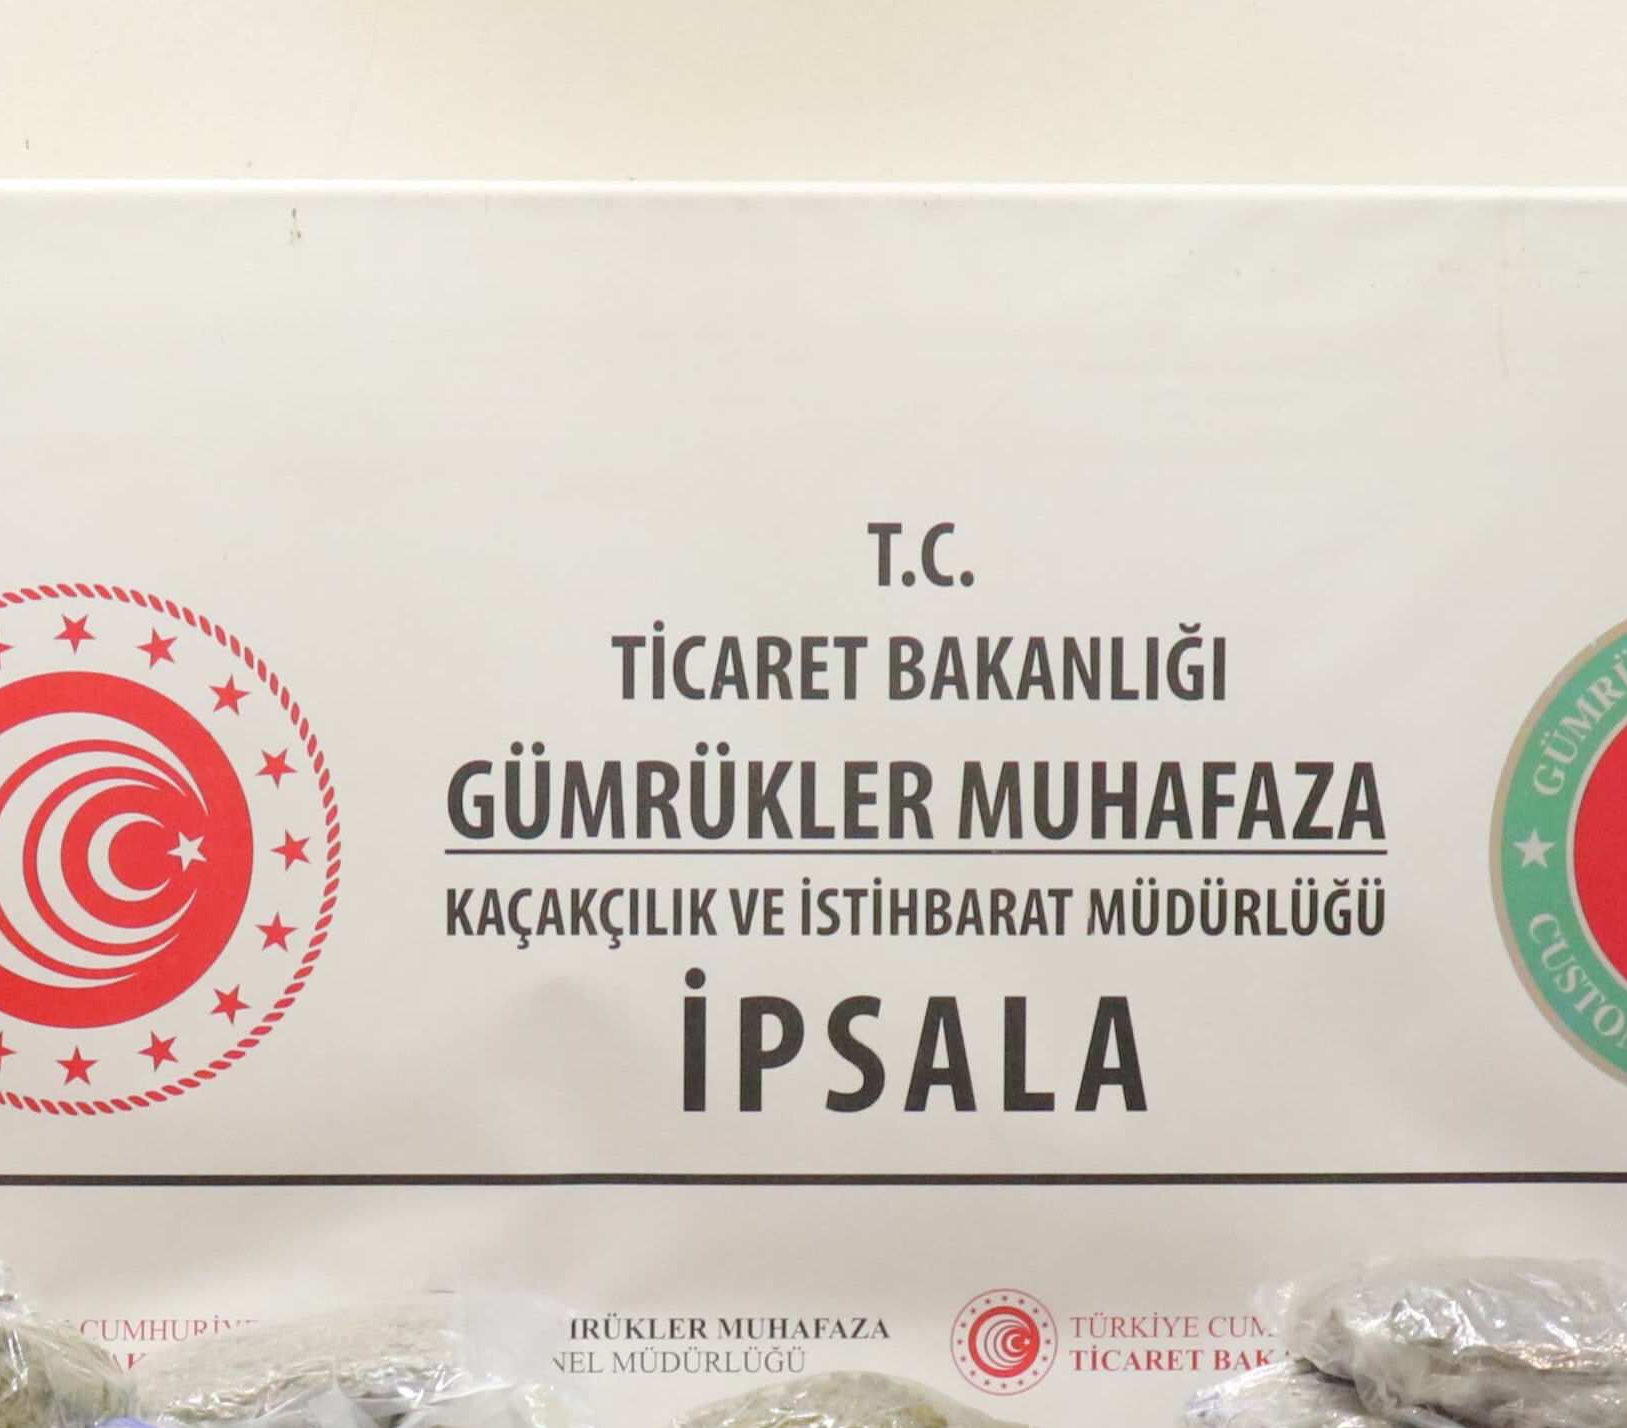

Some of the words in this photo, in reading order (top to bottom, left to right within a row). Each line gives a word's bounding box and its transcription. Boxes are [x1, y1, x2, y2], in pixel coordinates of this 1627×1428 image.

[867, 522, 975, 588] T.C.
[611, 619, 868, 701] TİCARET
[888, 622, 1227, 701] BAKANLIĞI
[447, 741, 934, 840] GÜMRÜKLER
[958, 761, 1386, 840] MUHAFAZA
[446, 887, 718, 950] KAÇAKÇILIK
[728, 888, 785, 936] VE
[801, 876, 1074, 936] İSTİHBARAT
[1086, 877, 1386, 937] MÜDÜRLÜĞÜ
[682, 967, 1148, 1114] İPSALA
[718, 1317, 891, 1340] MUHAFAZA
[1070, 1311, 1198, 1340] TÜRKİYE
[1070, 1345, 1204, 1372] TİCARET
[1214, 1349, 1290, 1372] BAK
[612, 1346, 806, 1374] MÜDÜRLÜĞÜ
